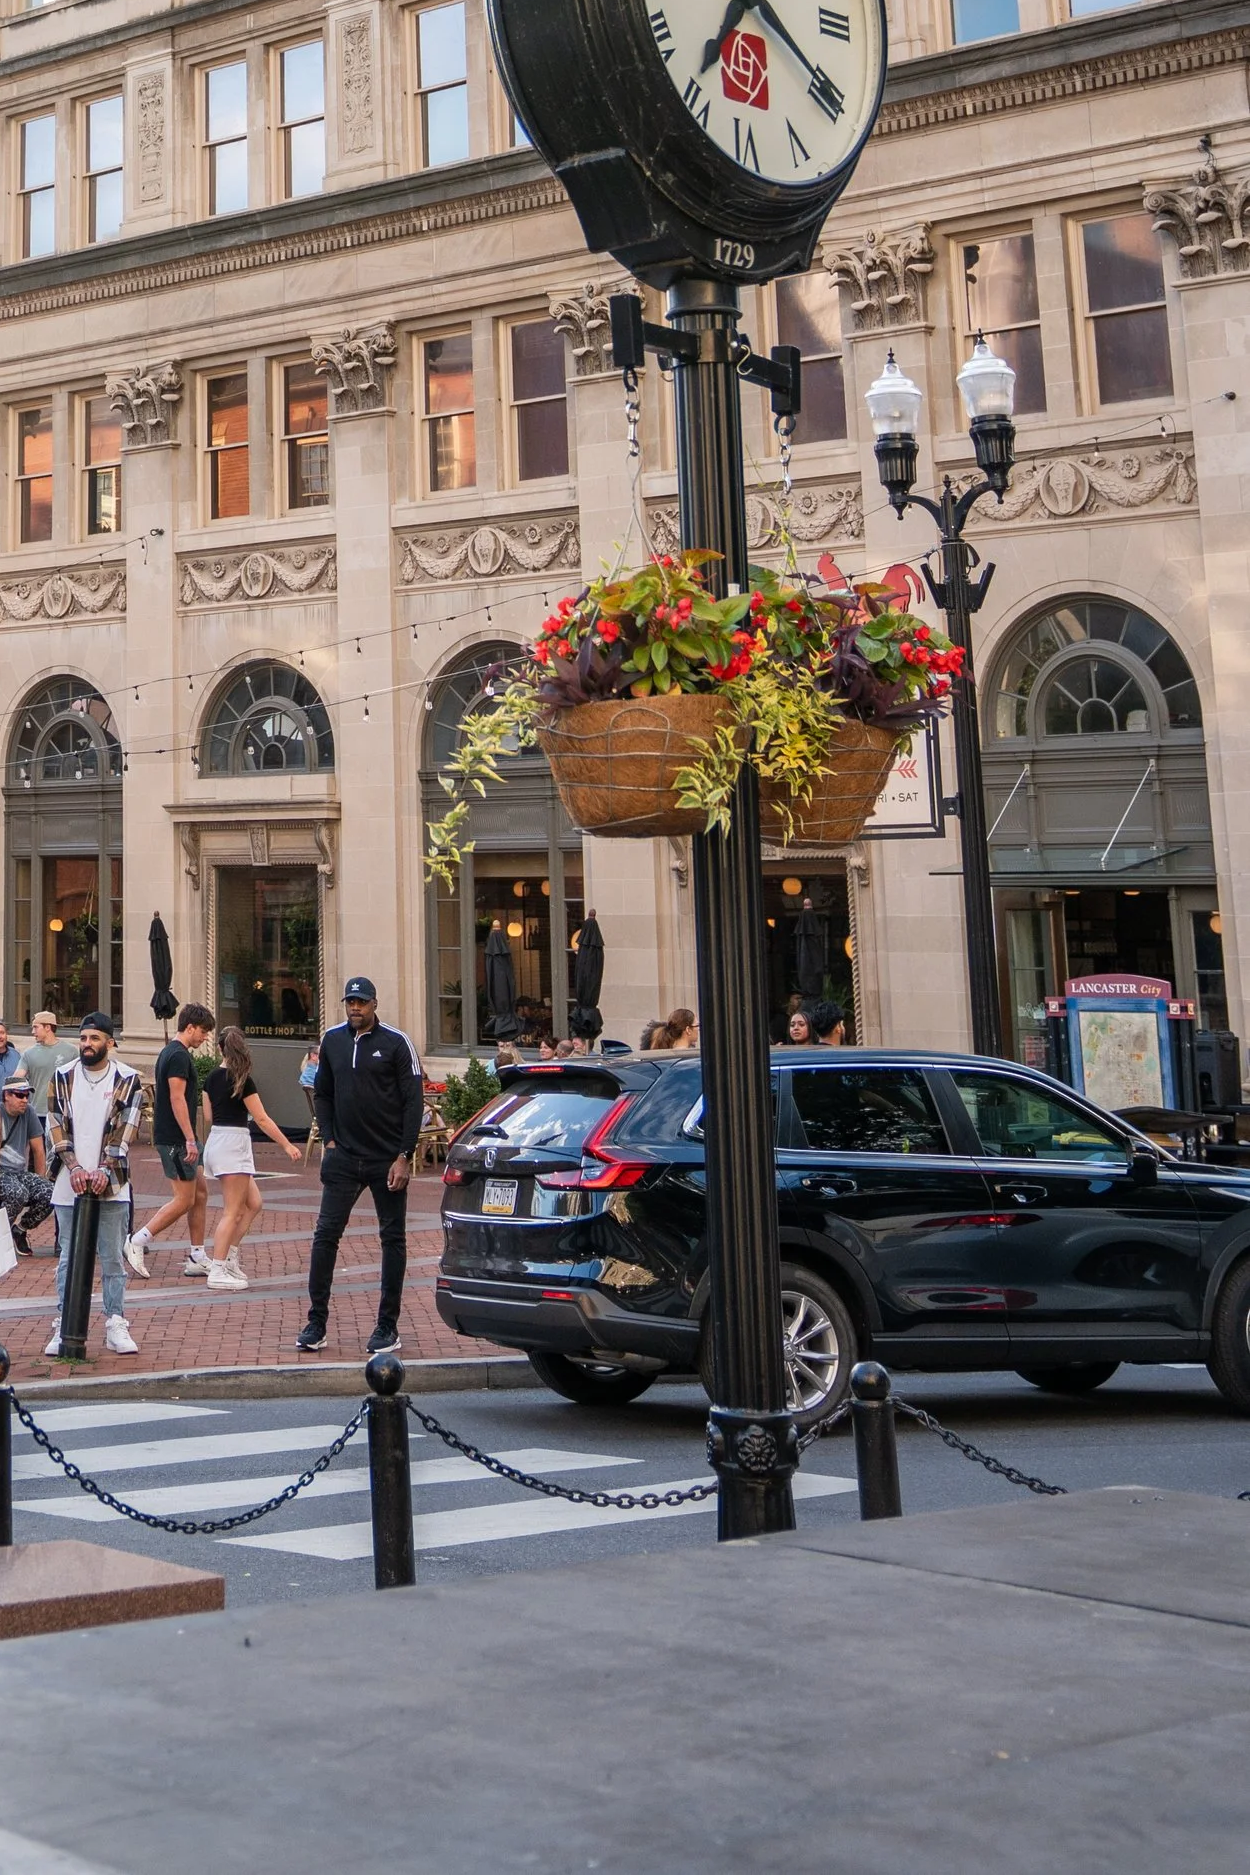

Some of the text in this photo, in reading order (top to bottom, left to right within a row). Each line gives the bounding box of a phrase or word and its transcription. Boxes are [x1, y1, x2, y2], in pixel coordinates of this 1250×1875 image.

[714, 237, 755, 269] 1729
[877, 792, 918, 803] RI SAT
[1071, 983, 1162, 997] LANCASTER City
[244, 1026, 295, 1036] BOTTLE SHOP
